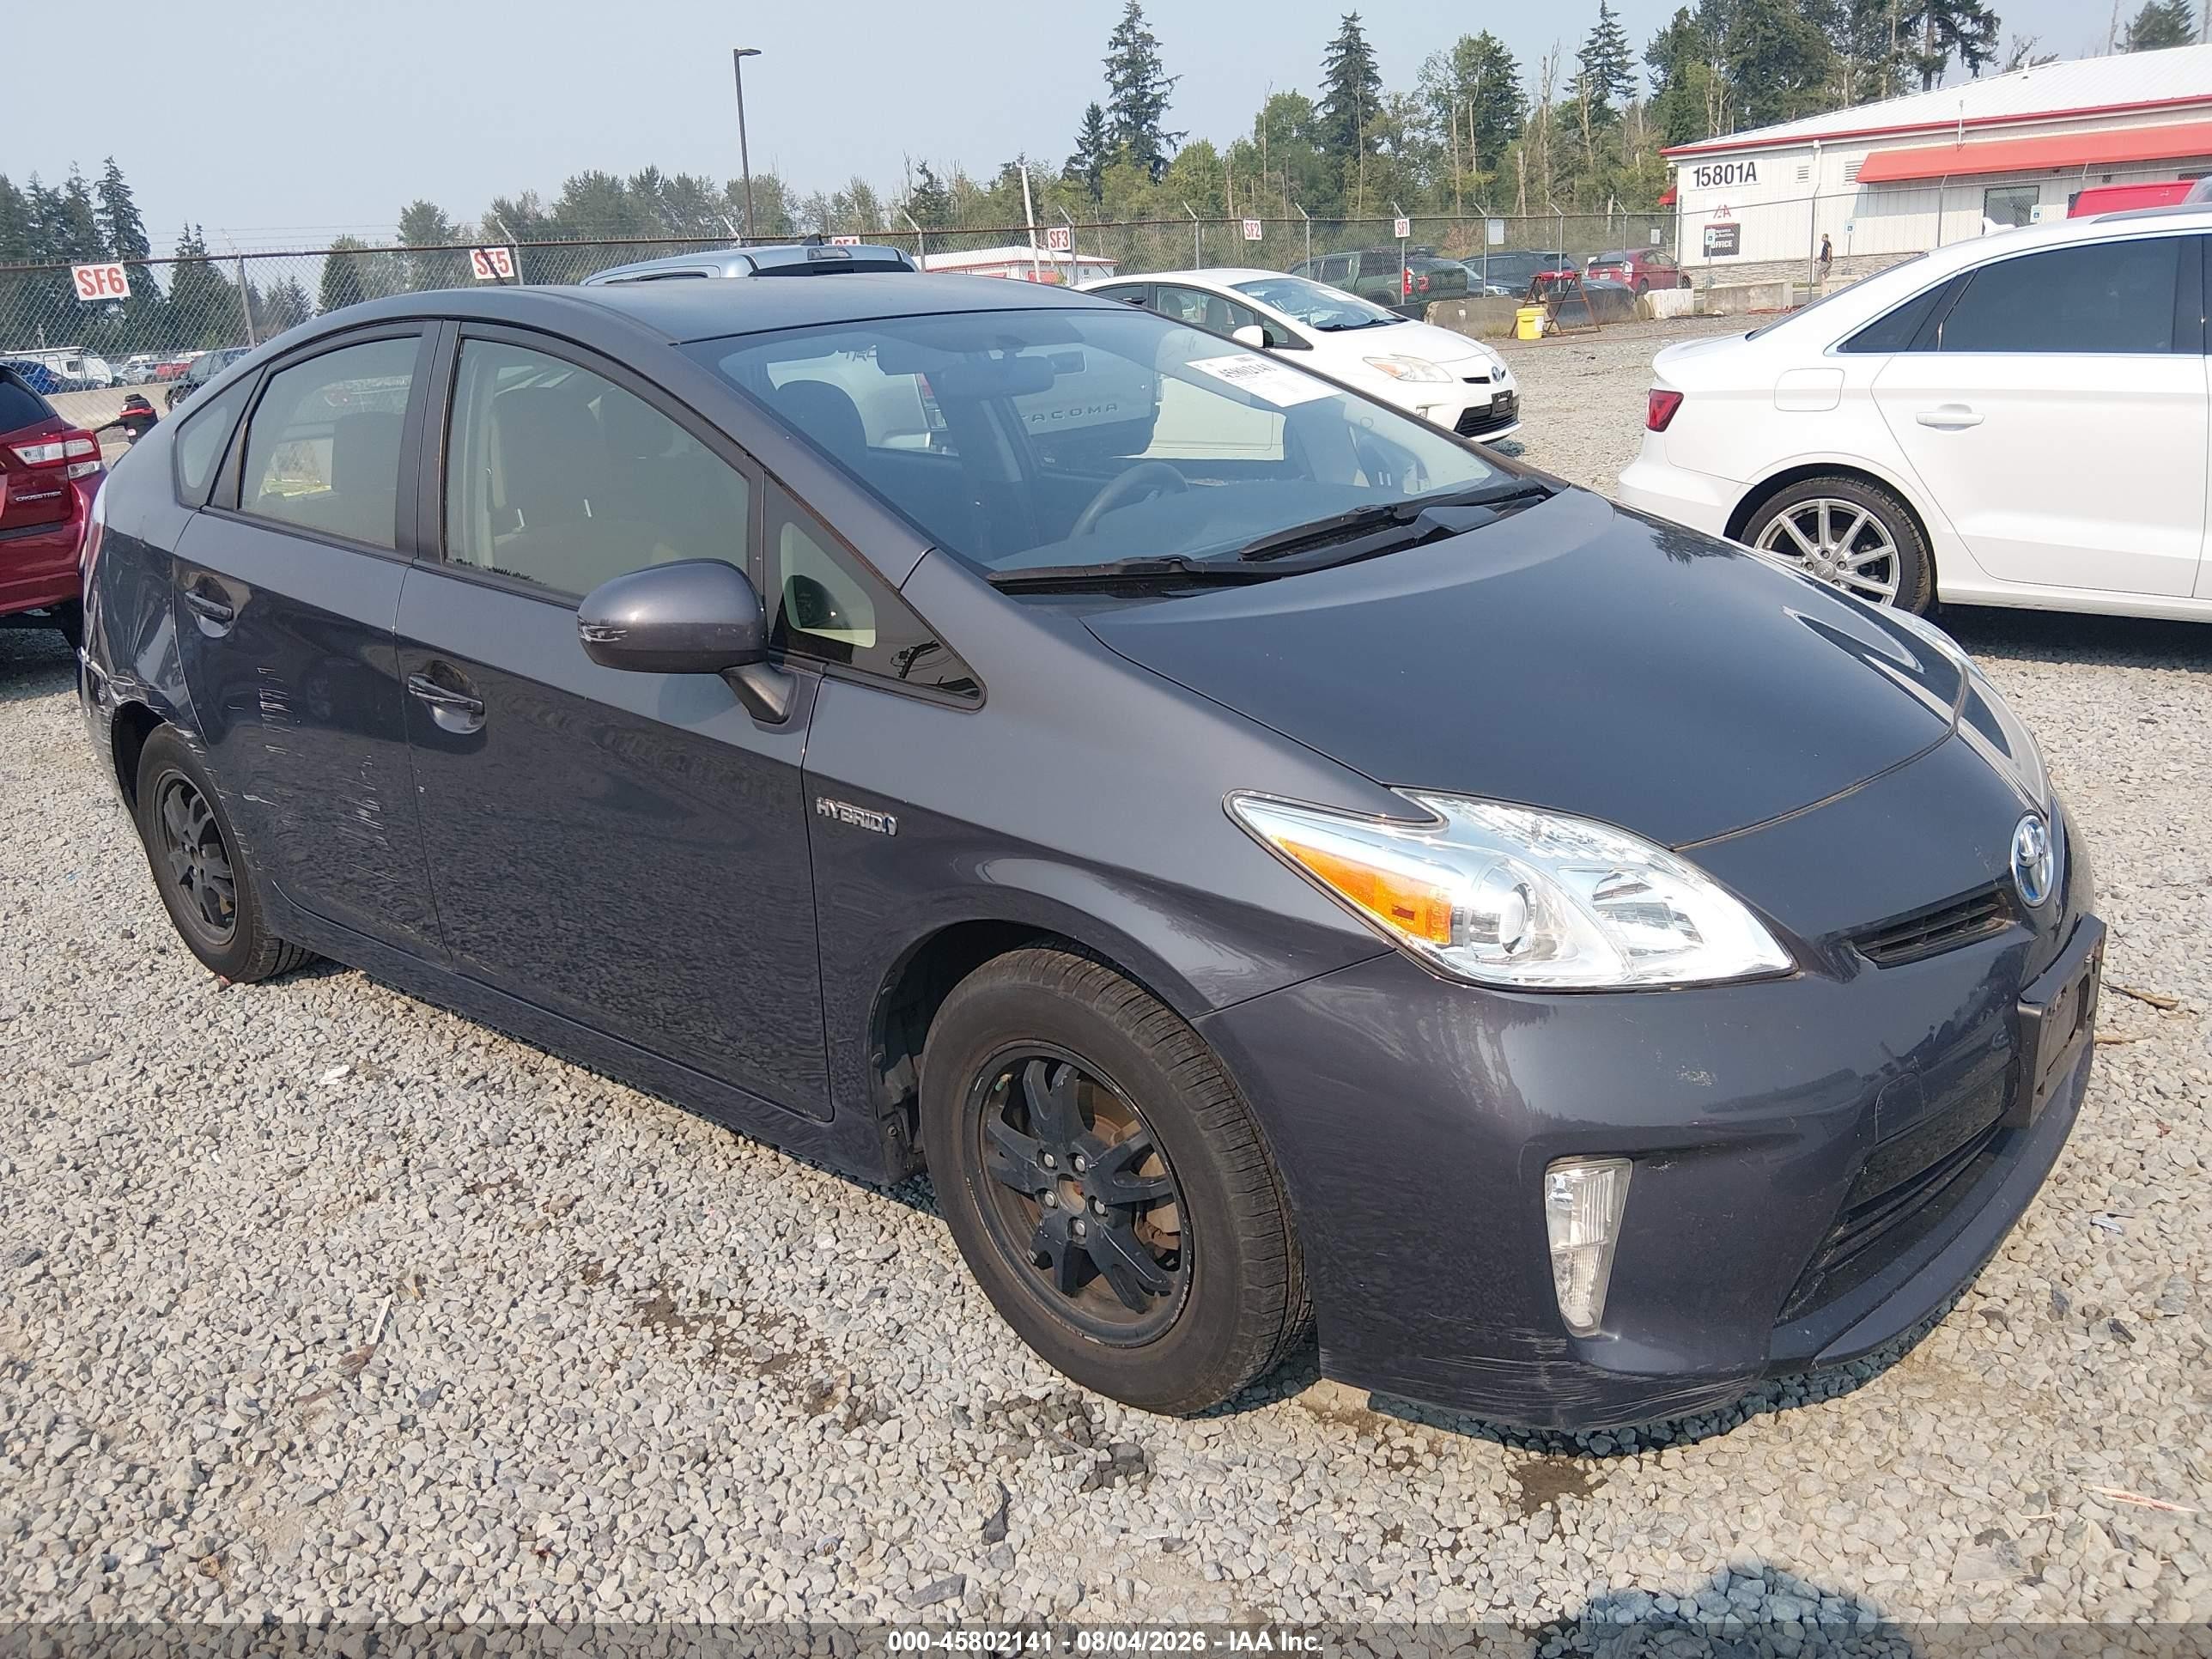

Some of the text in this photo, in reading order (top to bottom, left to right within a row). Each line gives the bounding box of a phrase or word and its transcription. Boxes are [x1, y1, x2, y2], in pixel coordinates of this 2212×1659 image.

[1692, 161, 1757, 187] 15801A
[1245, 222, 1261, 238] SF2
[1397, 221, 1408, 235] SF1
[1049, 230, 1069, 248] SF3
[77, 267, 125, 296] SF6
[1020, 404, 1118, 422] ACOMA
[817, 797, 884, 833] HYBRID
